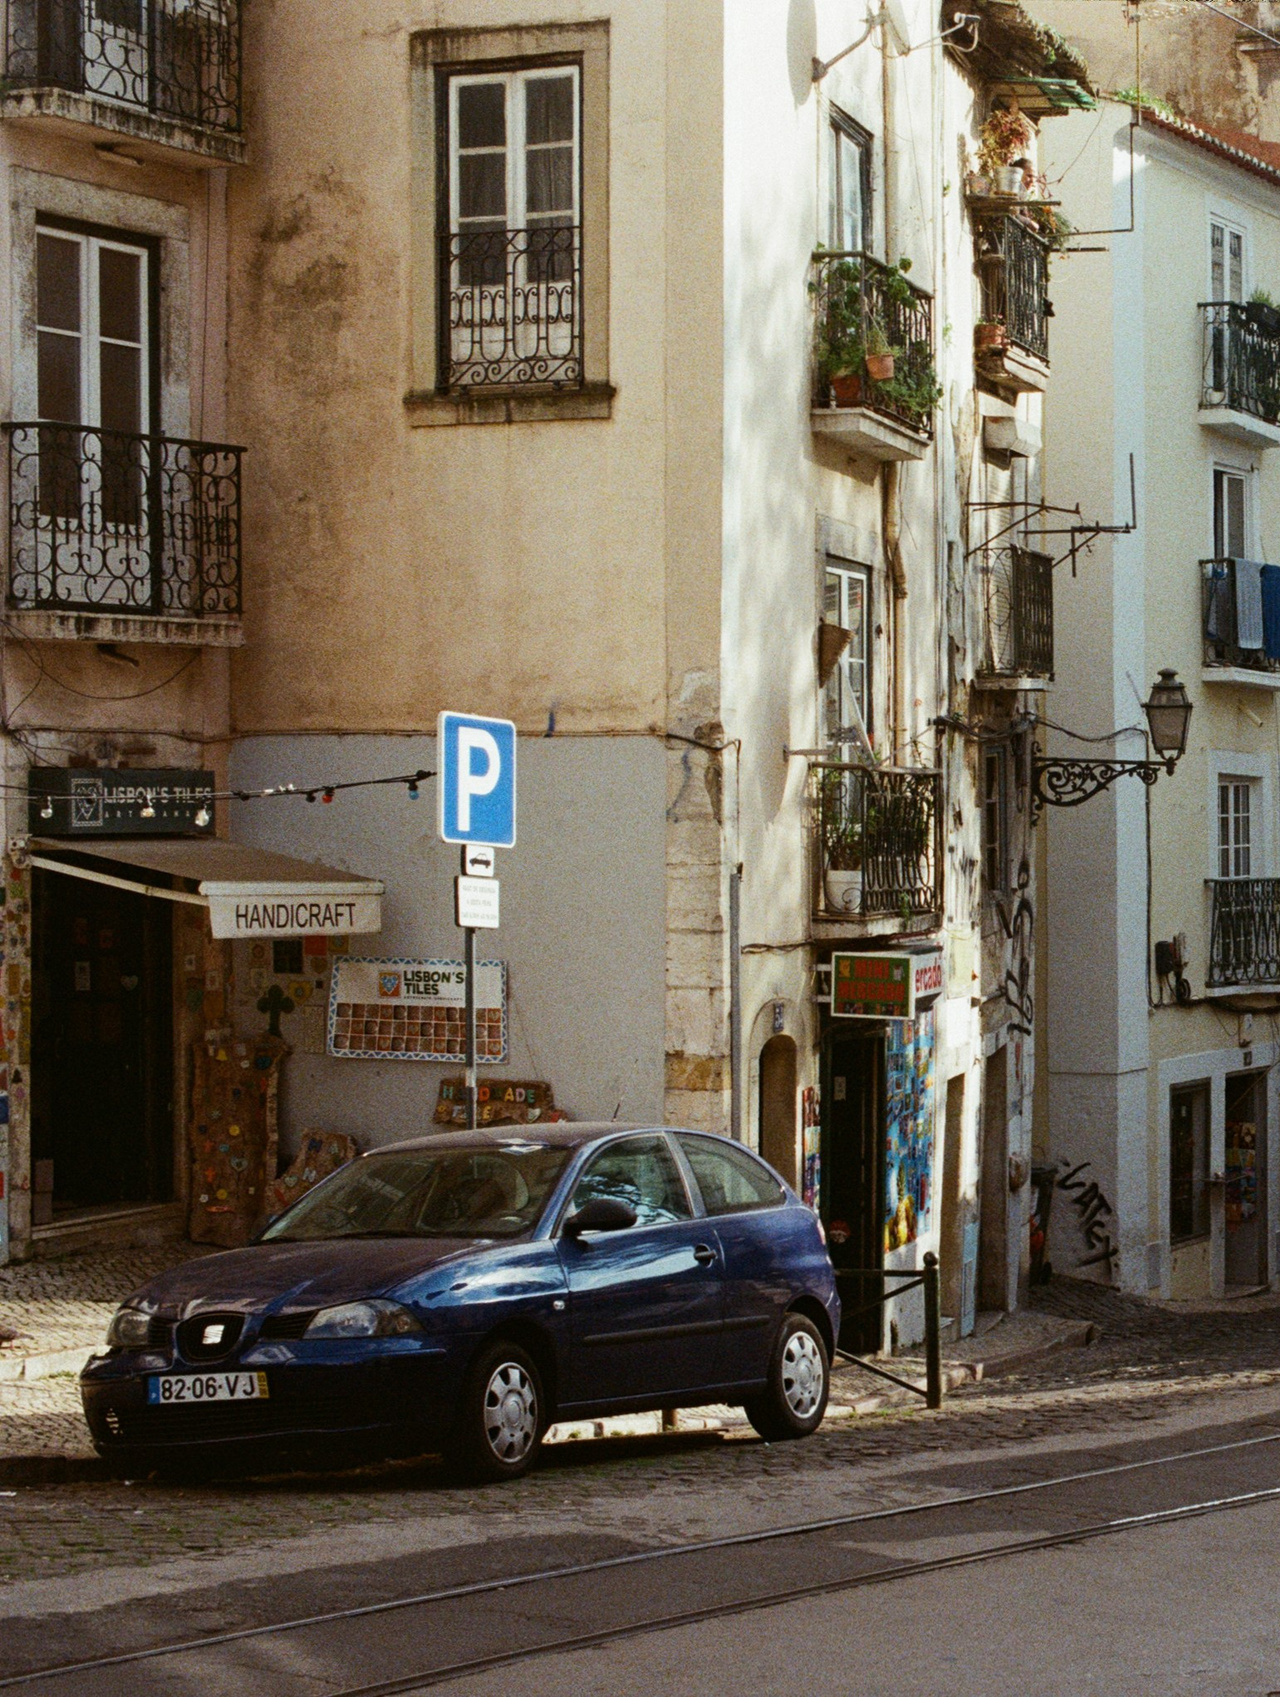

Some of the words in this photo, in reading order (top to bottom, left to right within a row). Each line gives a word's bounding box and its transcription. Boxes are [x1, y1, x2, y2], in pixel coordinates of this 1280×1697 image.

[457, 726, 501, 832] P
[103, 786, 169, 804] LISBON'S
[235, 903, 356, 929] HANDICRAFT
[403, 970, 465, 984] LISBON'S
[854, 960, 890, 980] MINI
[404, 983, 440, 996] TILES
[837, 981, 905, 1002] MERCADO
